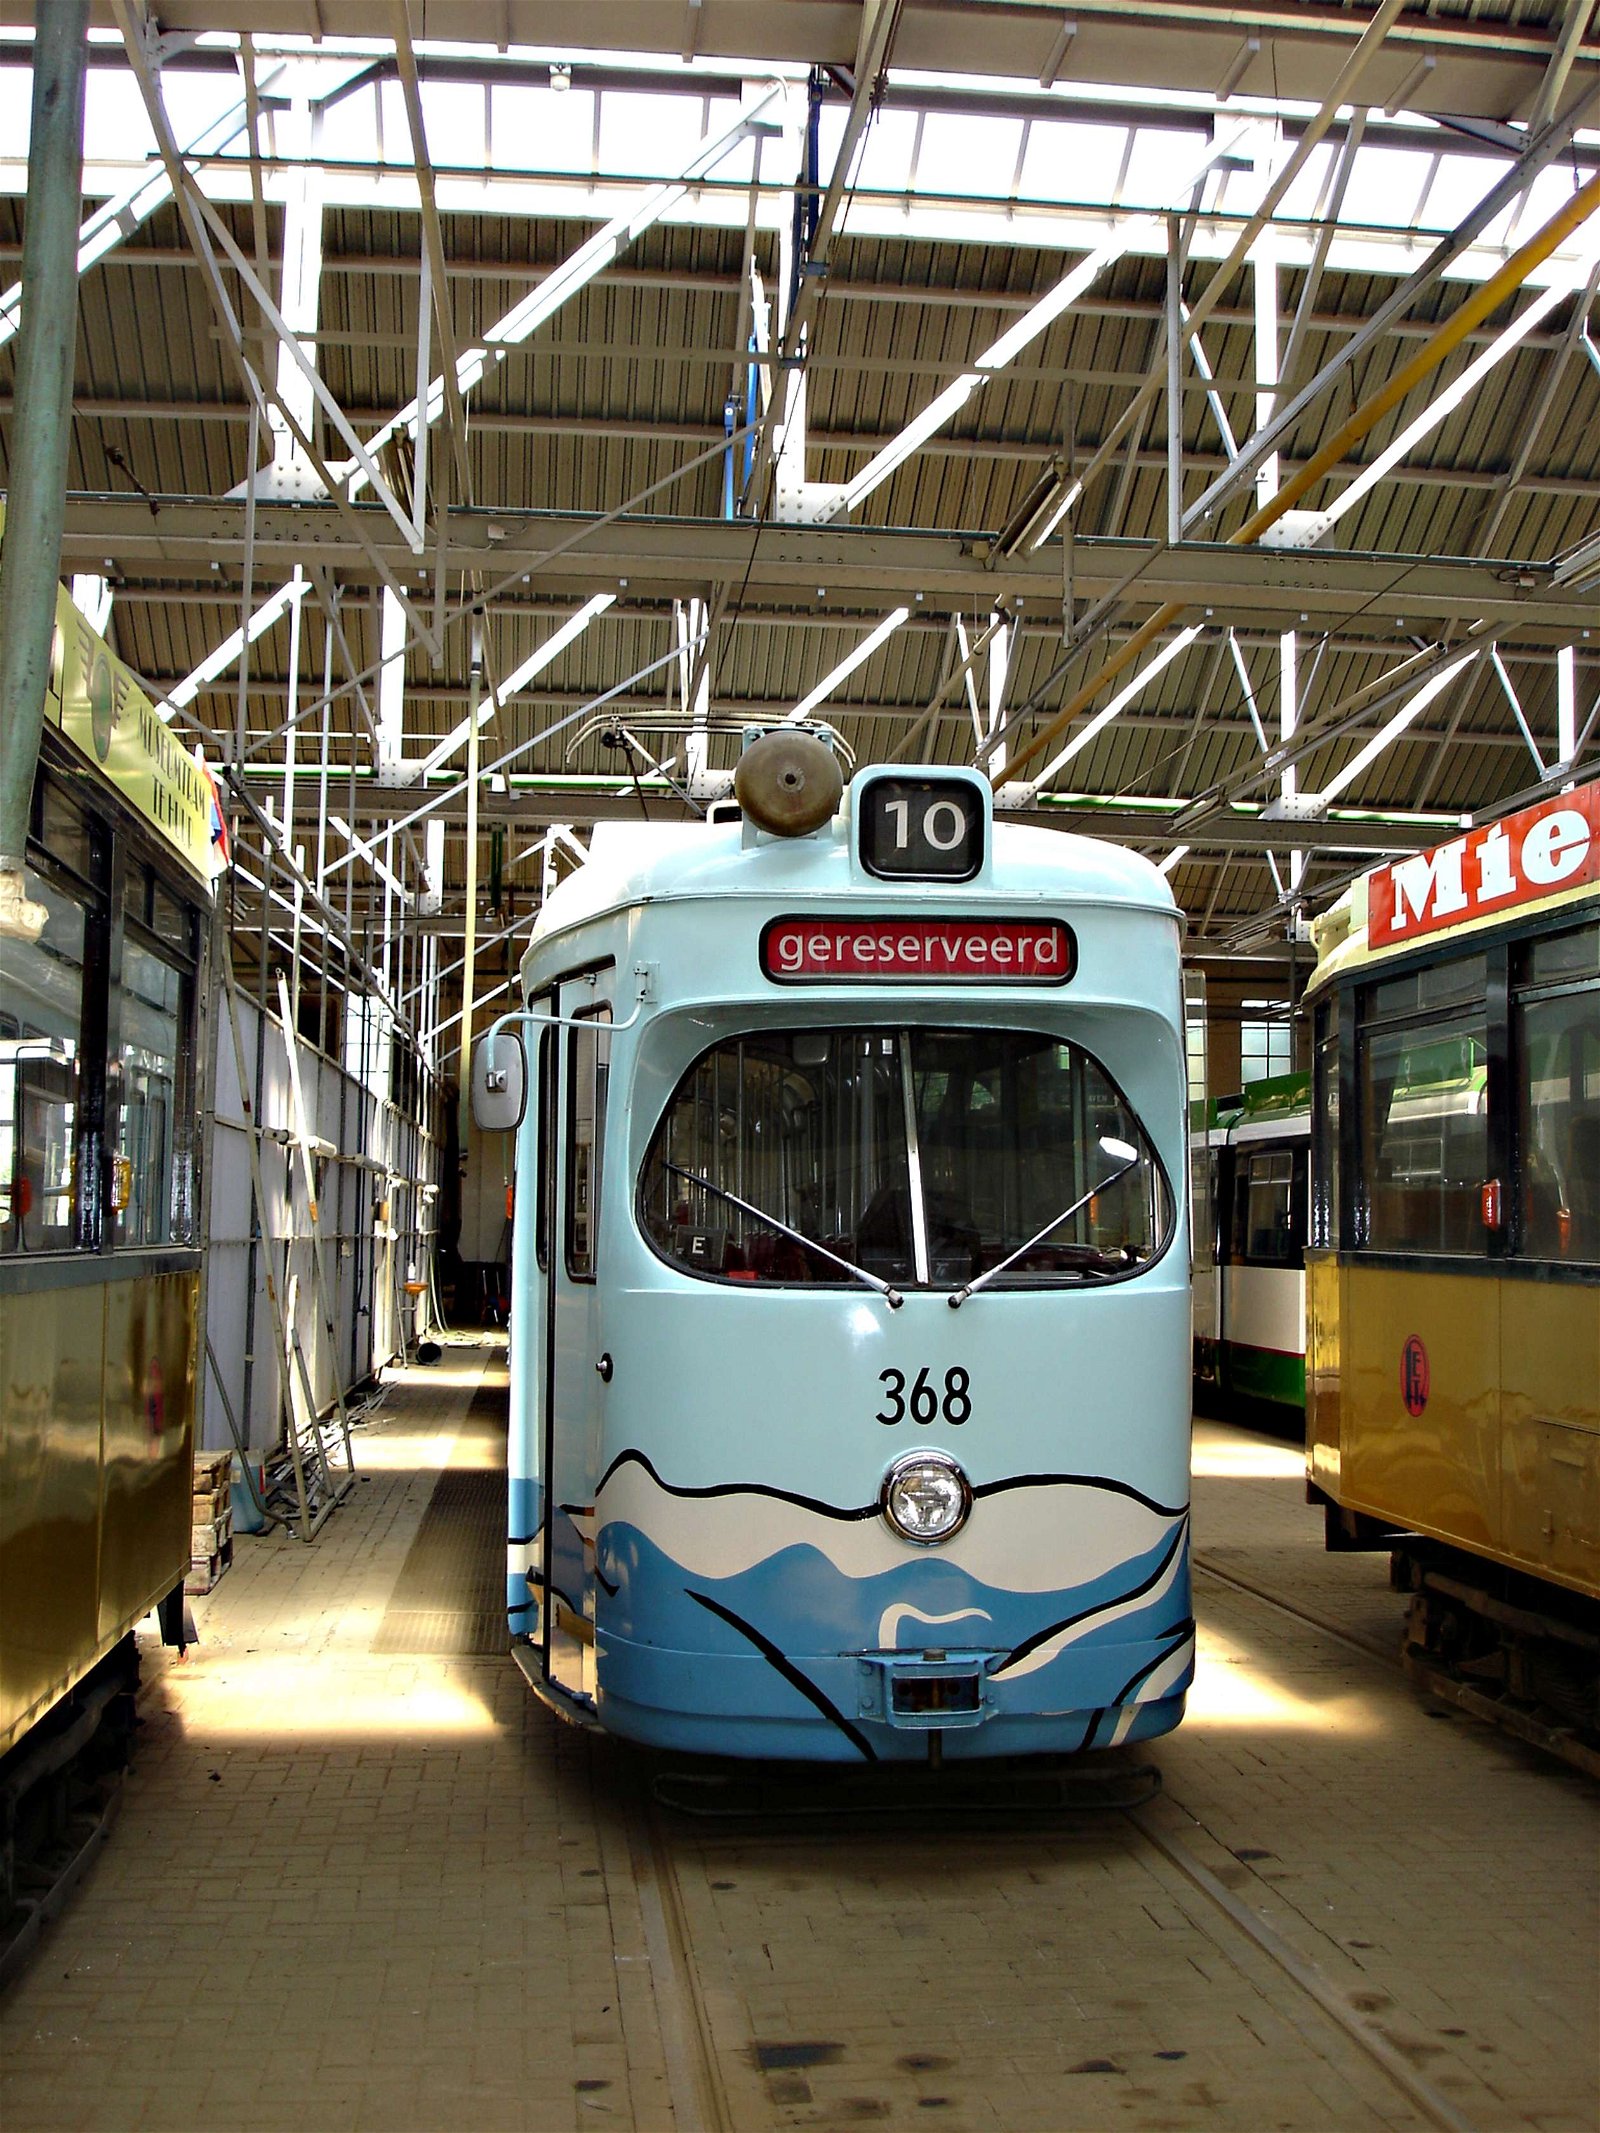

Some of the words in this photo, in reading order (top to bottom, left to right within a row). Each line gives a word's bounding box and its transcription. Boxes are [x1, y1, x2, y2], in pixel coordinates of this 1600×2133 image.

[151, 773, 165, 824] TE
[884, 800, 967, 851] 10
[1390, 809, 1591, 931] Mie
[778, 926, 1059, 972] gereserveerd
[691, 1236, 706, 1254] E
[875, 1366, 972, 1426] 368
